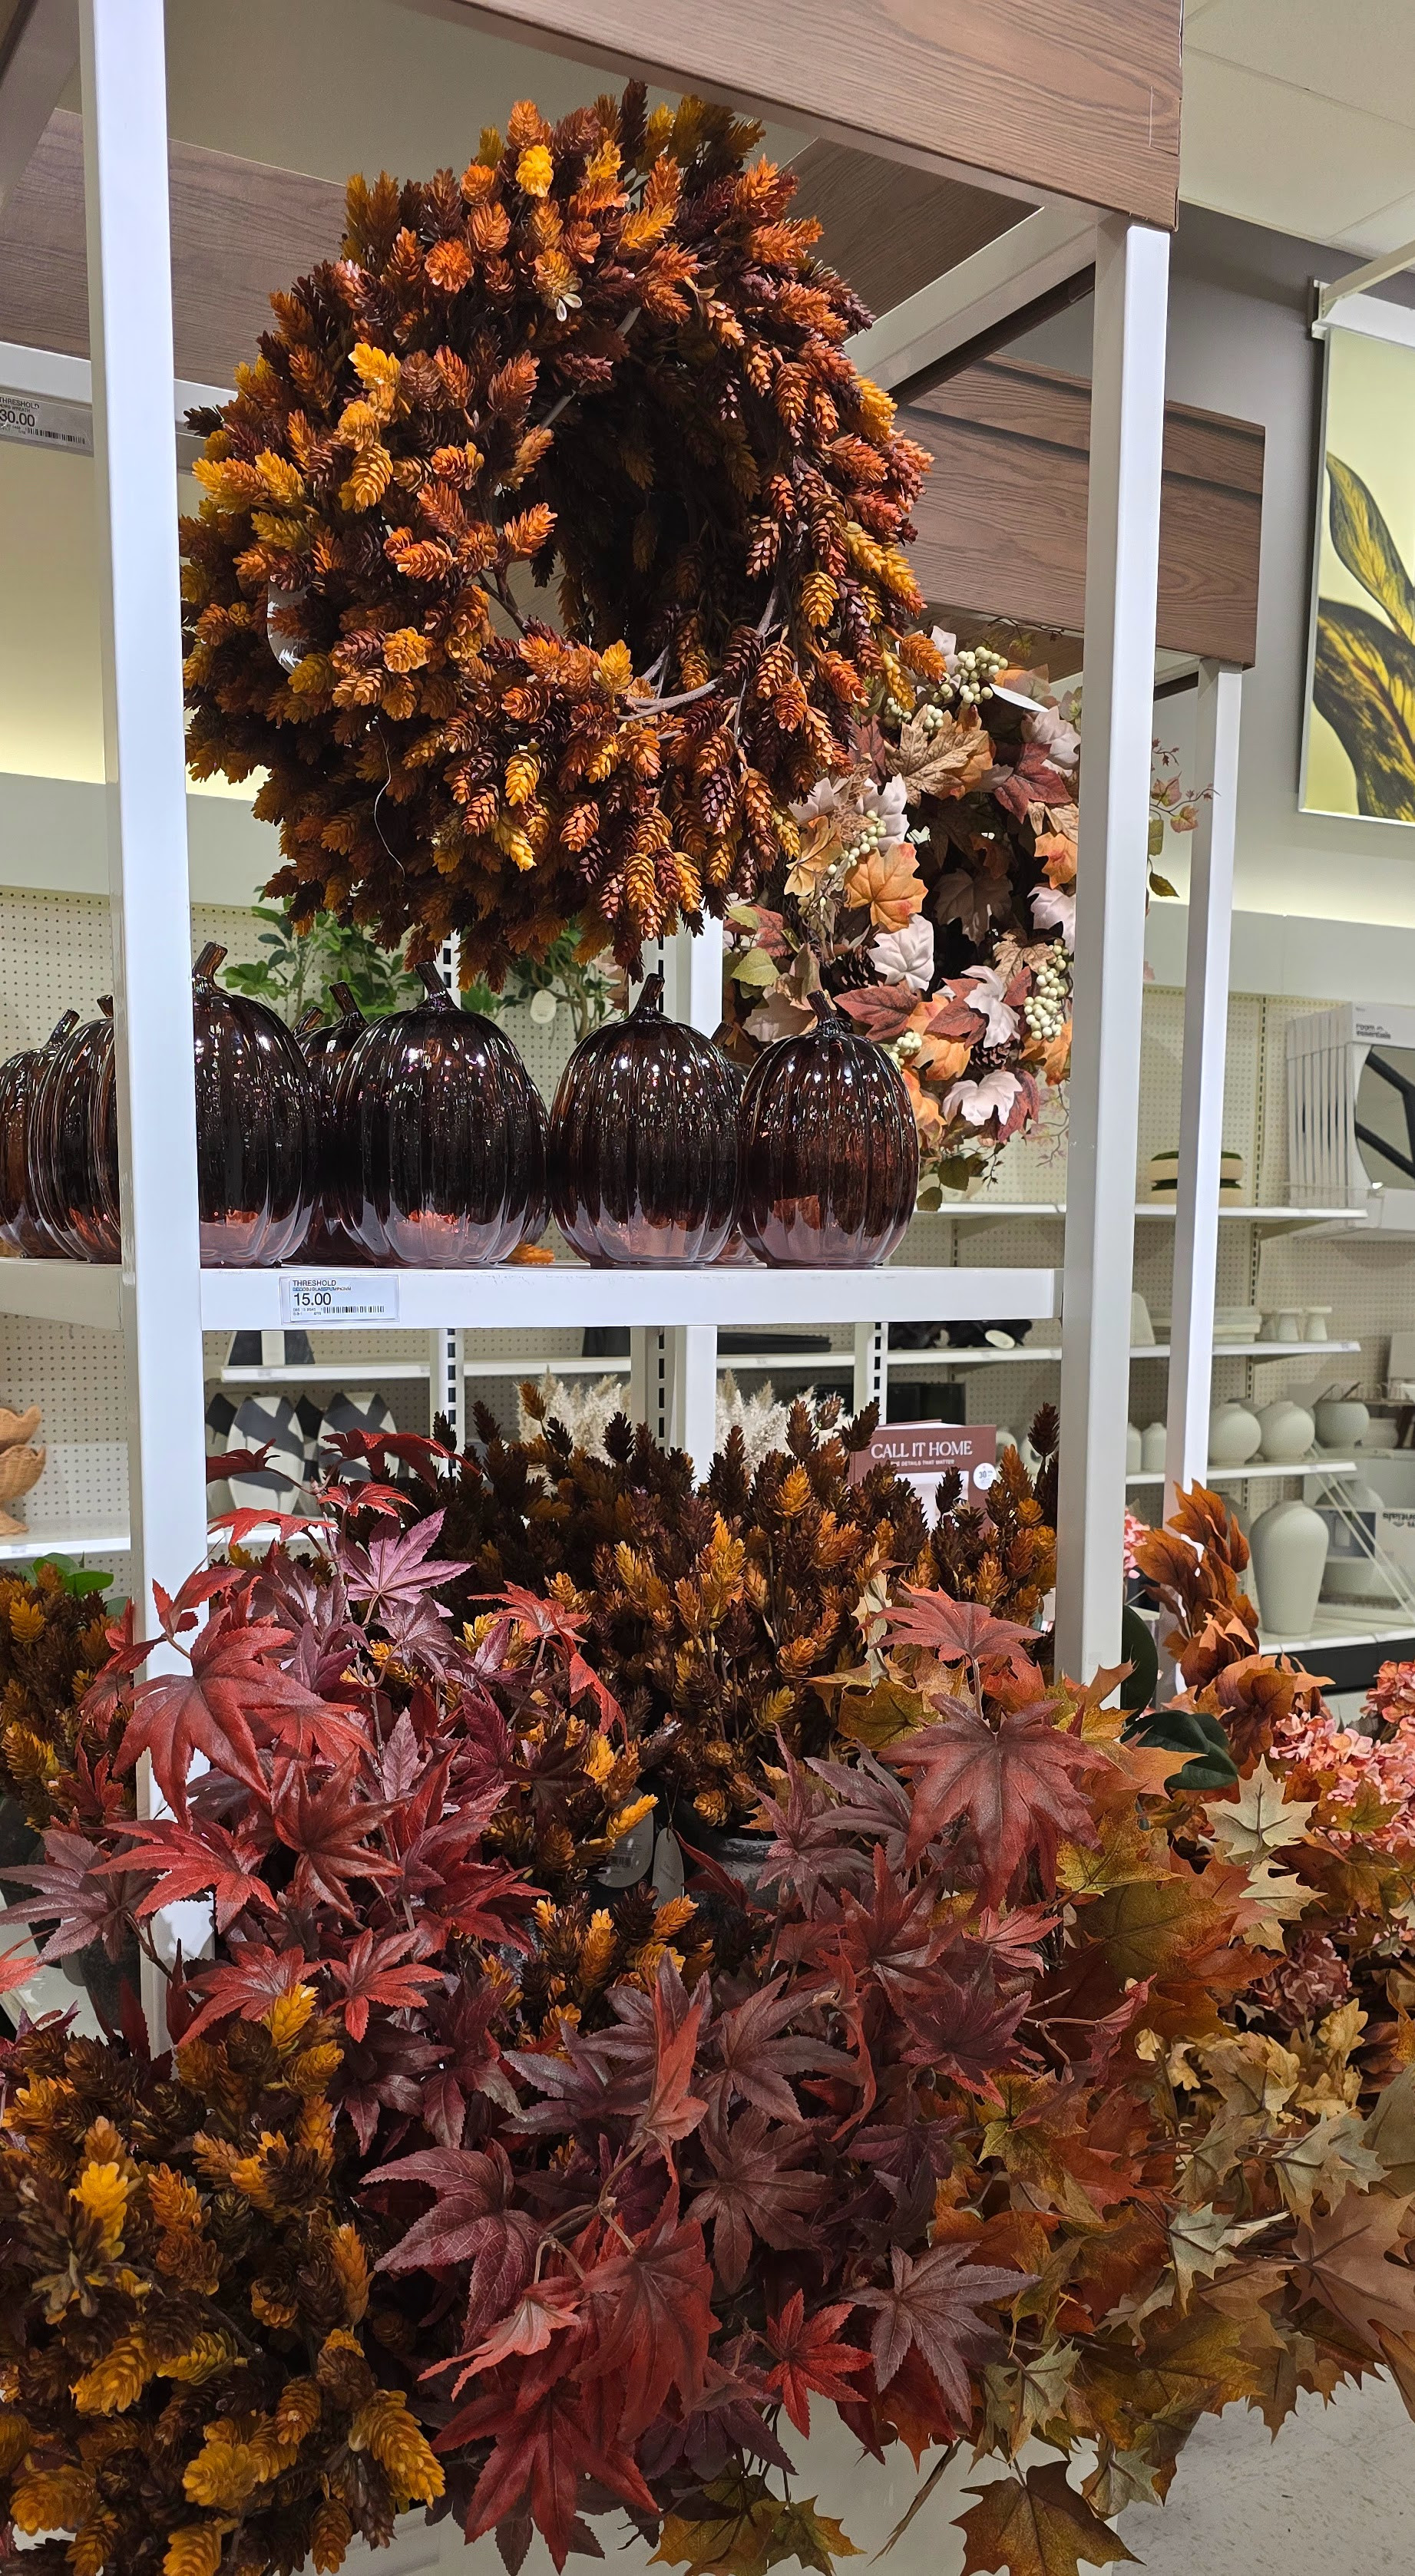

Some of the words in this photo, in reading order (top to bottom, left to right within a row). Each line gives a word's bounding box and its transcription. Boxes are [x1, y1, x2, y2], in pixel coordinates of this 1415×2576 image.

[0, 409, 35, 427] 30.00
[294, 1293, 332, 1306] 15.00
[871, 1442, 909, 1458] CALL
[912, 1442, 926, 1457] IT
[929, 1441, 973, 1457] HOME
